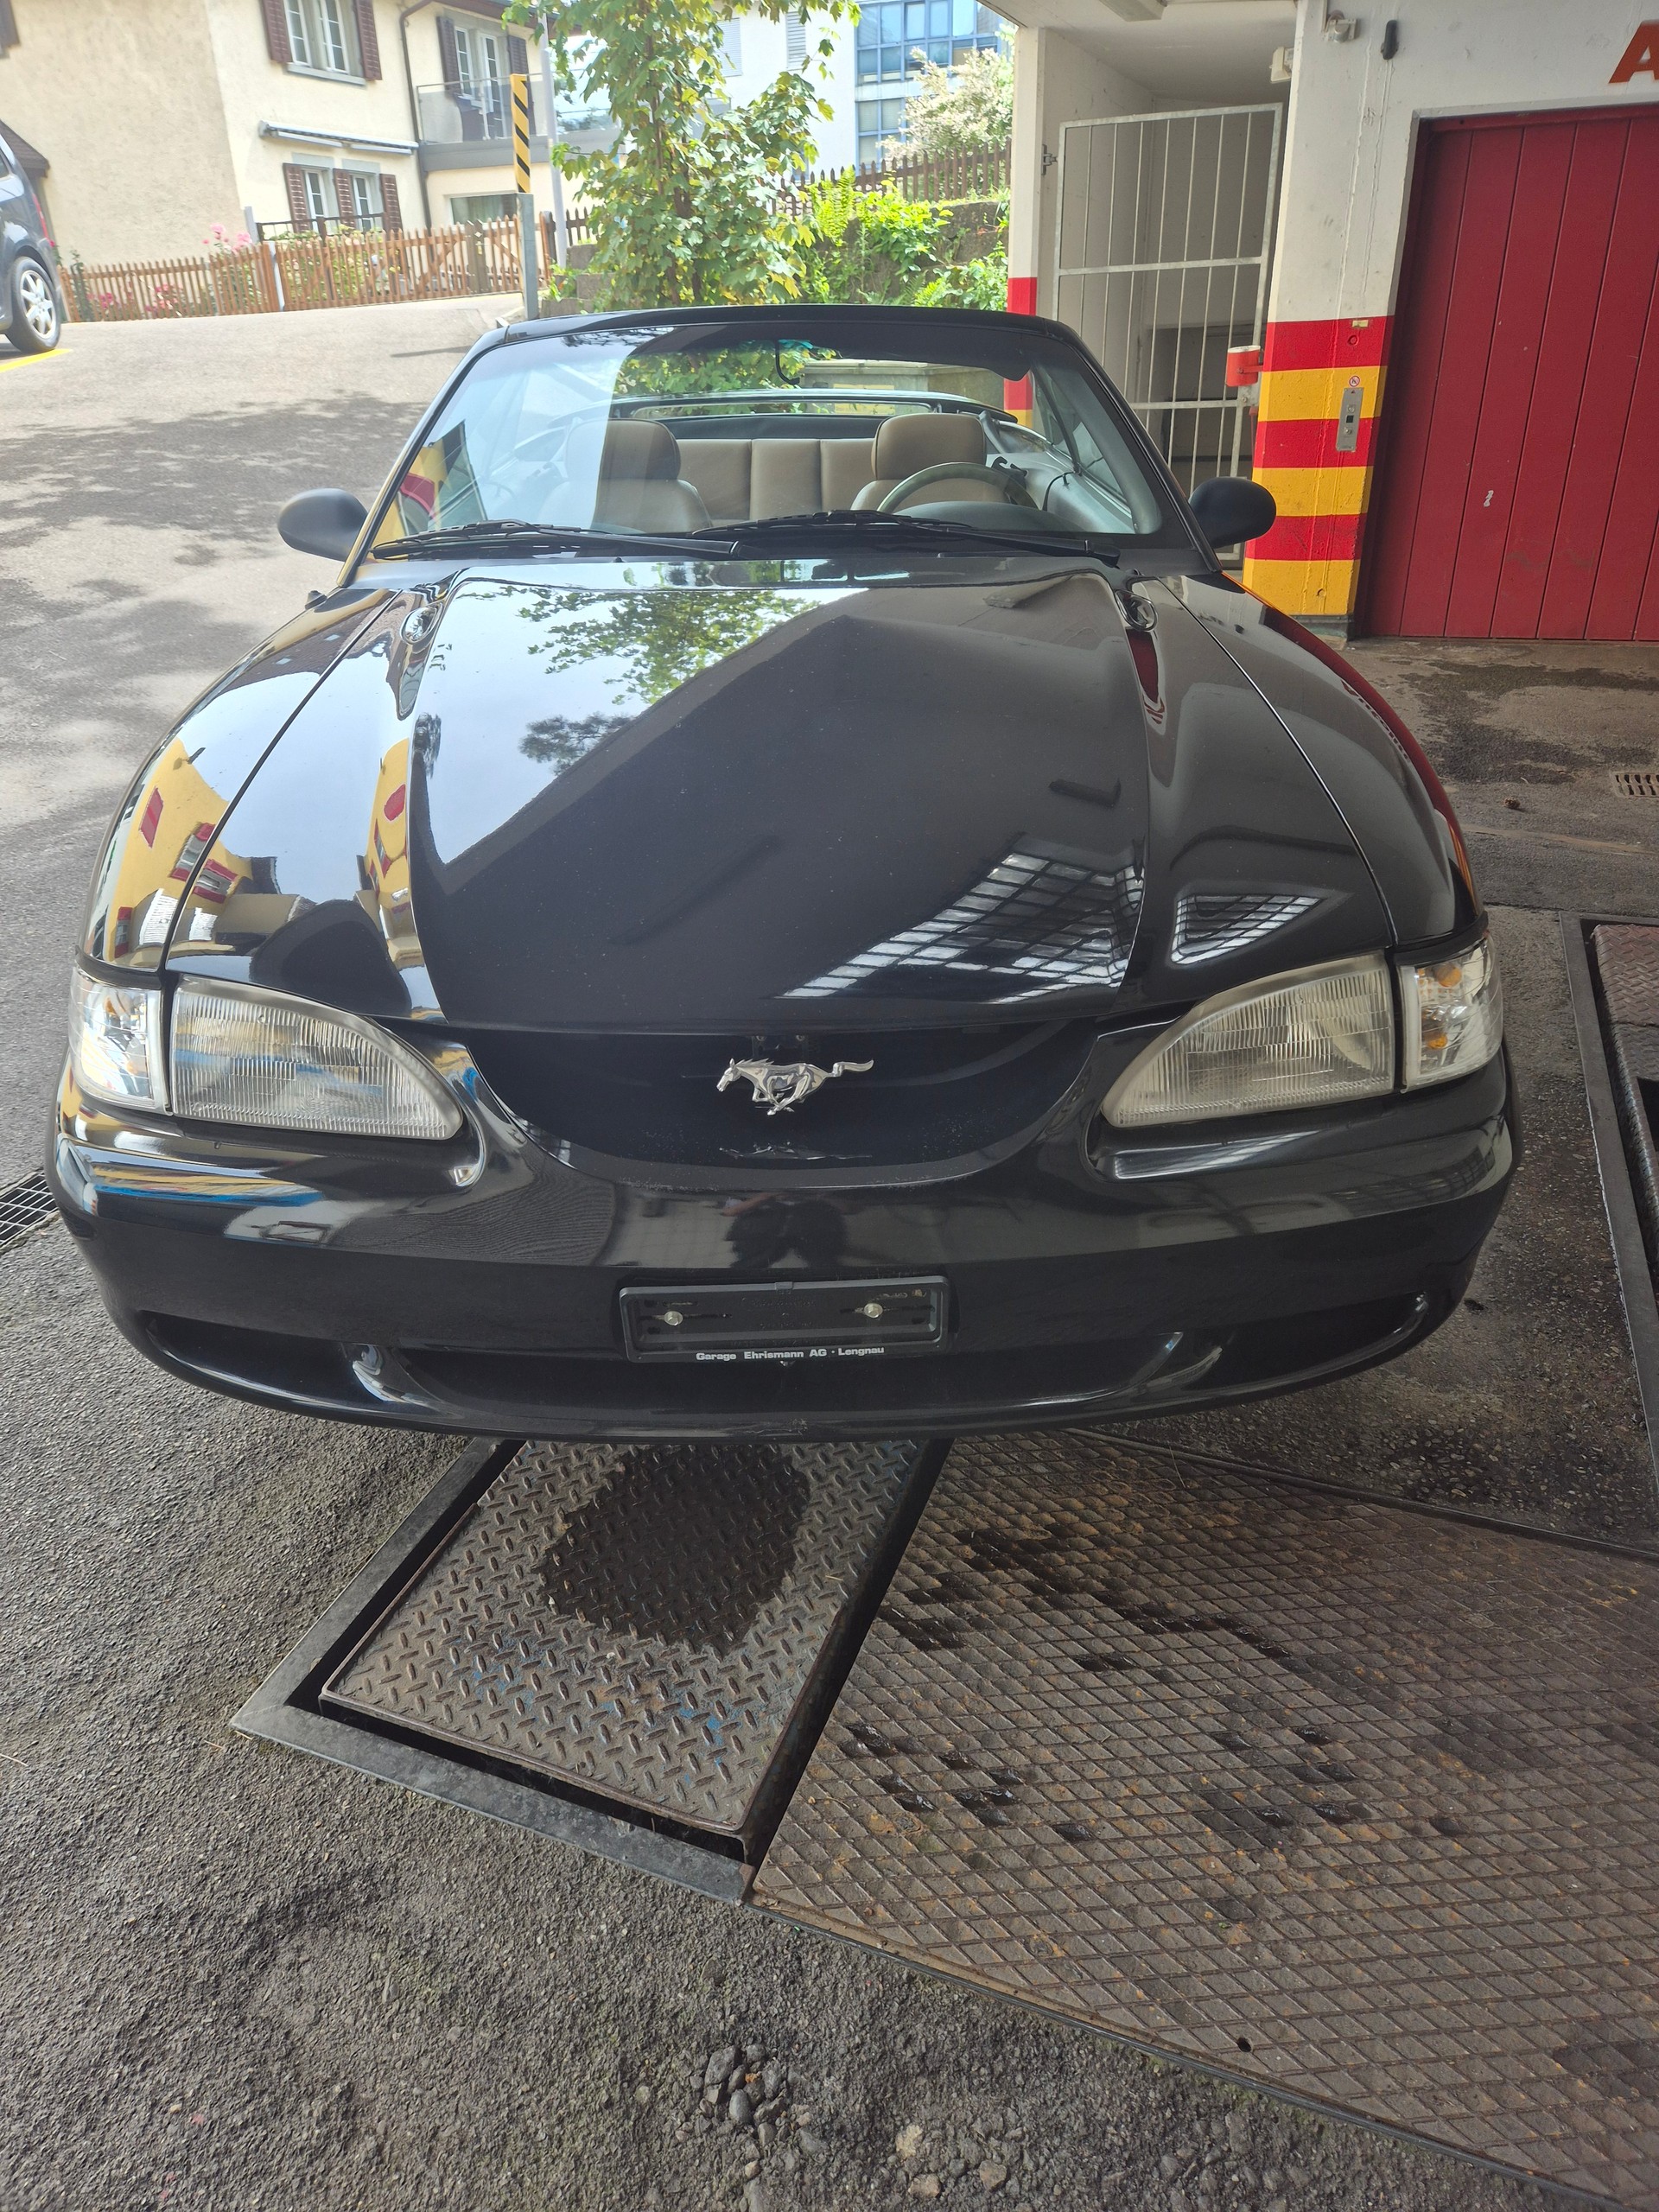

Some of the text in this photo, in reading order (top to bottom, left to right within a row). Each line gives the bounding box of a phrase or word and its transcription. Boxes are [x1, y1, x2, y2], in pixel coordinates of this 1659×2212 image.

[696, 1347, 885, 1362] Garage Ehrismann AG Lengnau
